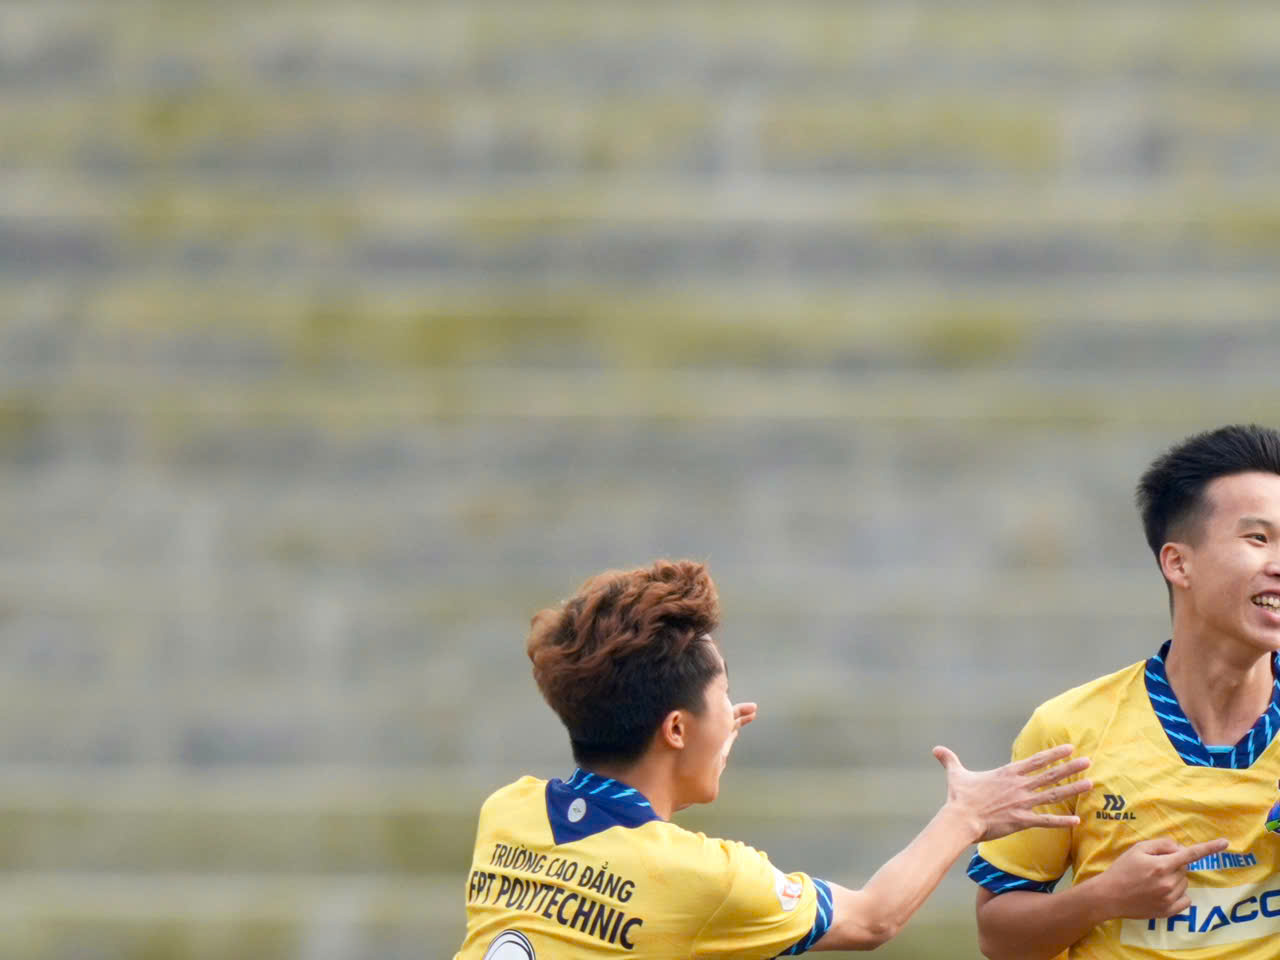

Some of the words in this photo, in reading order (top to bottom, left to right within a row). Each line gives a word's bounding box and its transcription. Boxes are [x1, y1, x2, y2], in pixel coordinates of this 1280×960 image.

[546, 858, 578, 882] CAO
[469, 871, 496, 904] FPT
[493, 875, 643, 950] POLYTECHNIC
